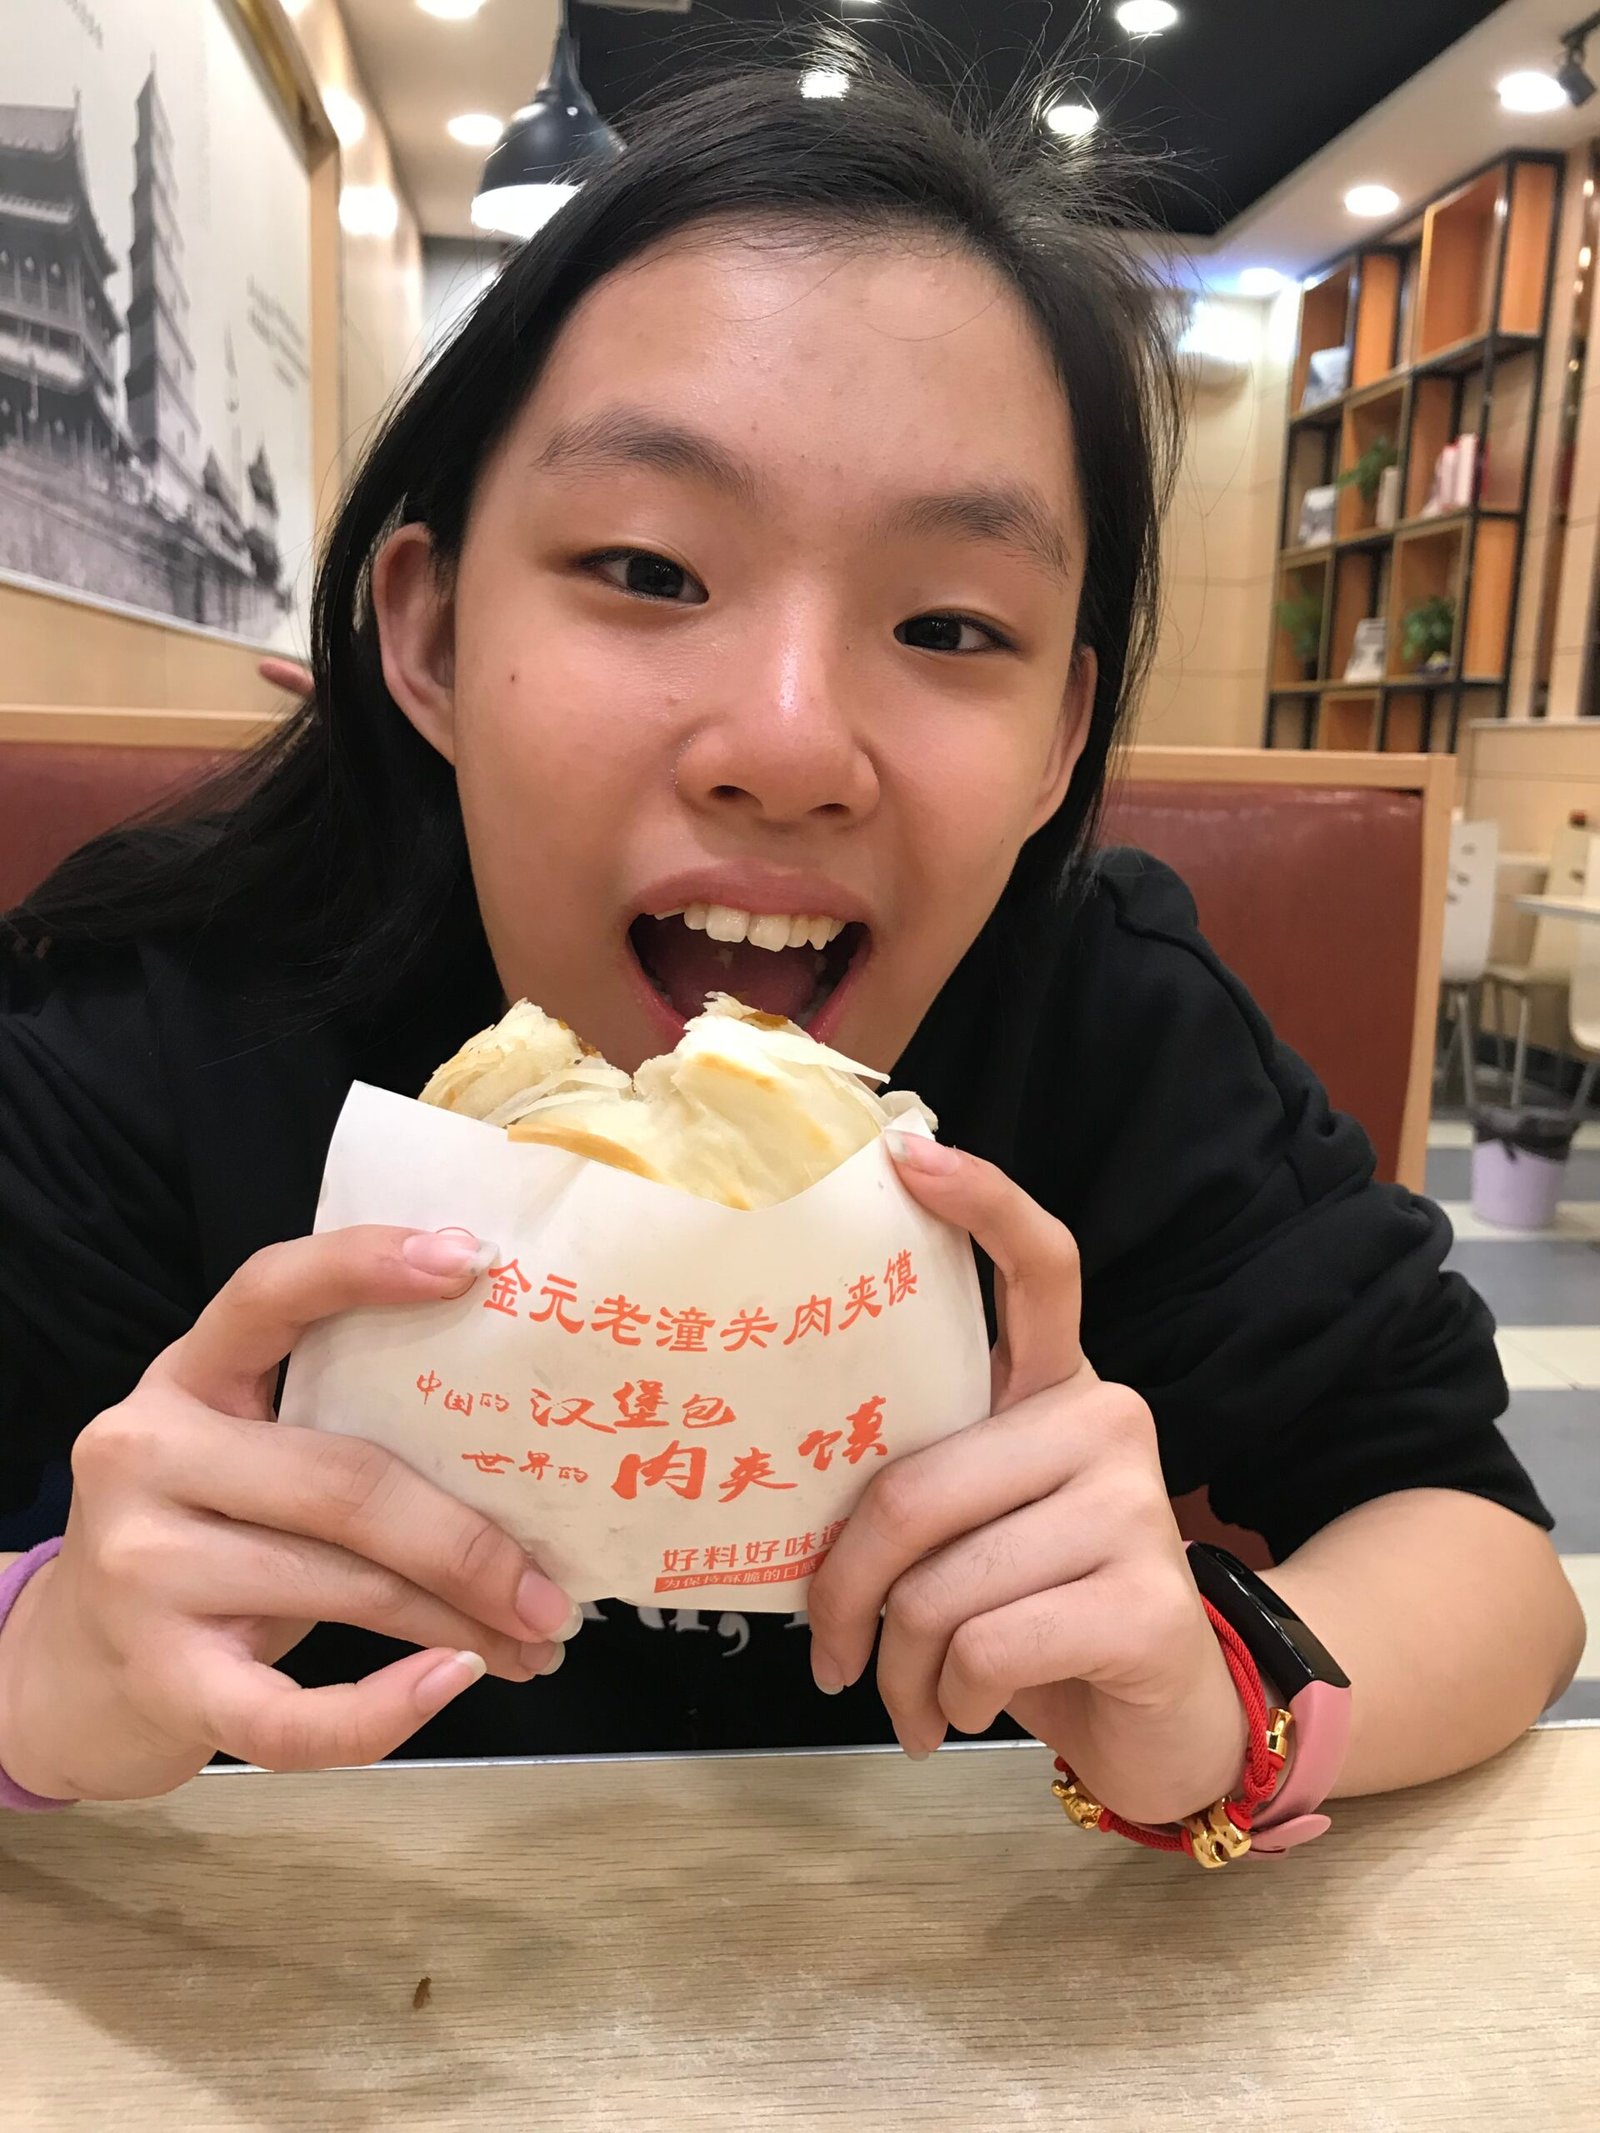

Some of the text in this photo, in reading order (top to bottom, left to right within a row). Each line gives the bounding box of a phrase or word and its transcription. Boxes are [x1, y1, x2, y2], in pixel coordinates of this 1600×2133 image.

[483, 1249, 918, 1352] 金元老潼关肉夹馍
[661, 1517, 850, 1573] 好料好味道
